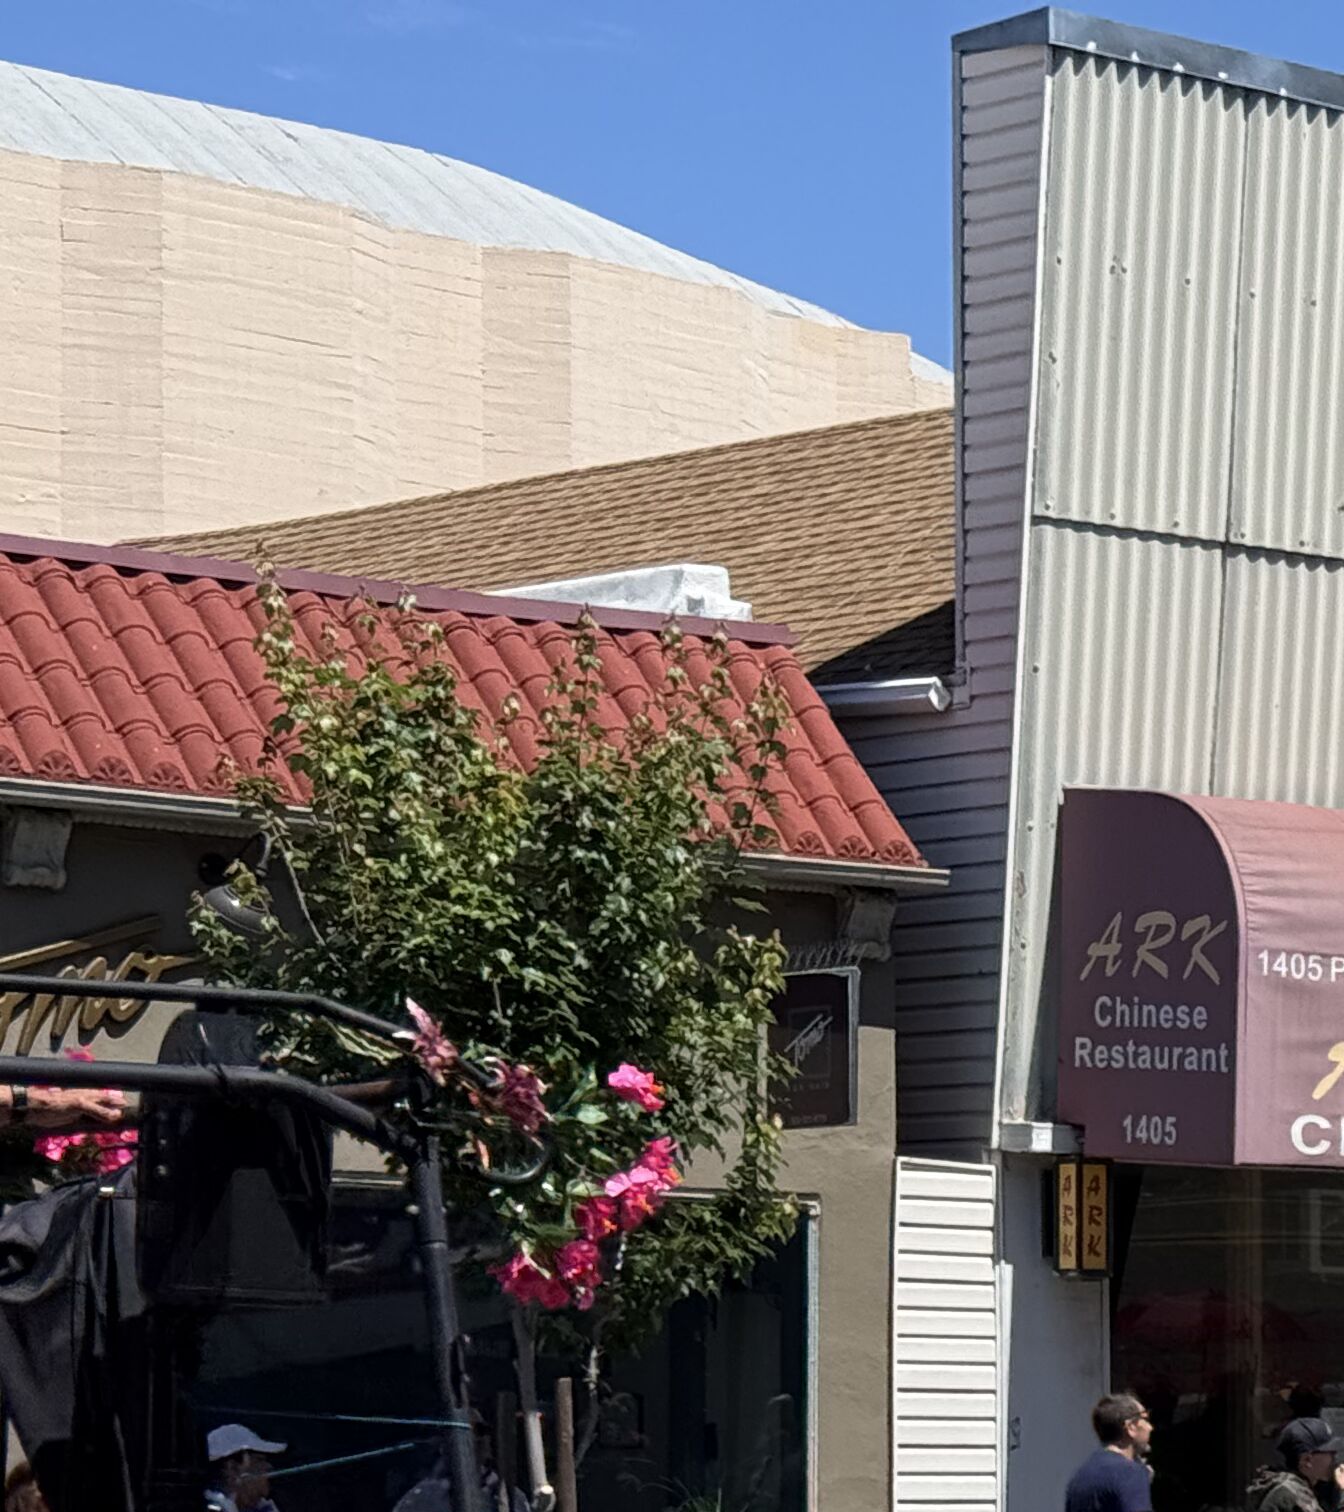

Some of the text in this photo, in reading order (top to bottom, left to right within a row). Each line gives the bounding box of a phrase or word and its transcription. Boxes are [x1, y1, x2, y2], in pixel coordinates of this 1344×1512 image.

[1080, 910, 1228, 986] ARK
[1257, 949, 1323, 983] 1405
[1094, 994, 1209, 1031] Chinese
[1073, 1036, 1229, 1075] Restaurant
[1121, 1114, 1178, 1146] 1405
[1086, 1174, 1103, 1258] ARK
